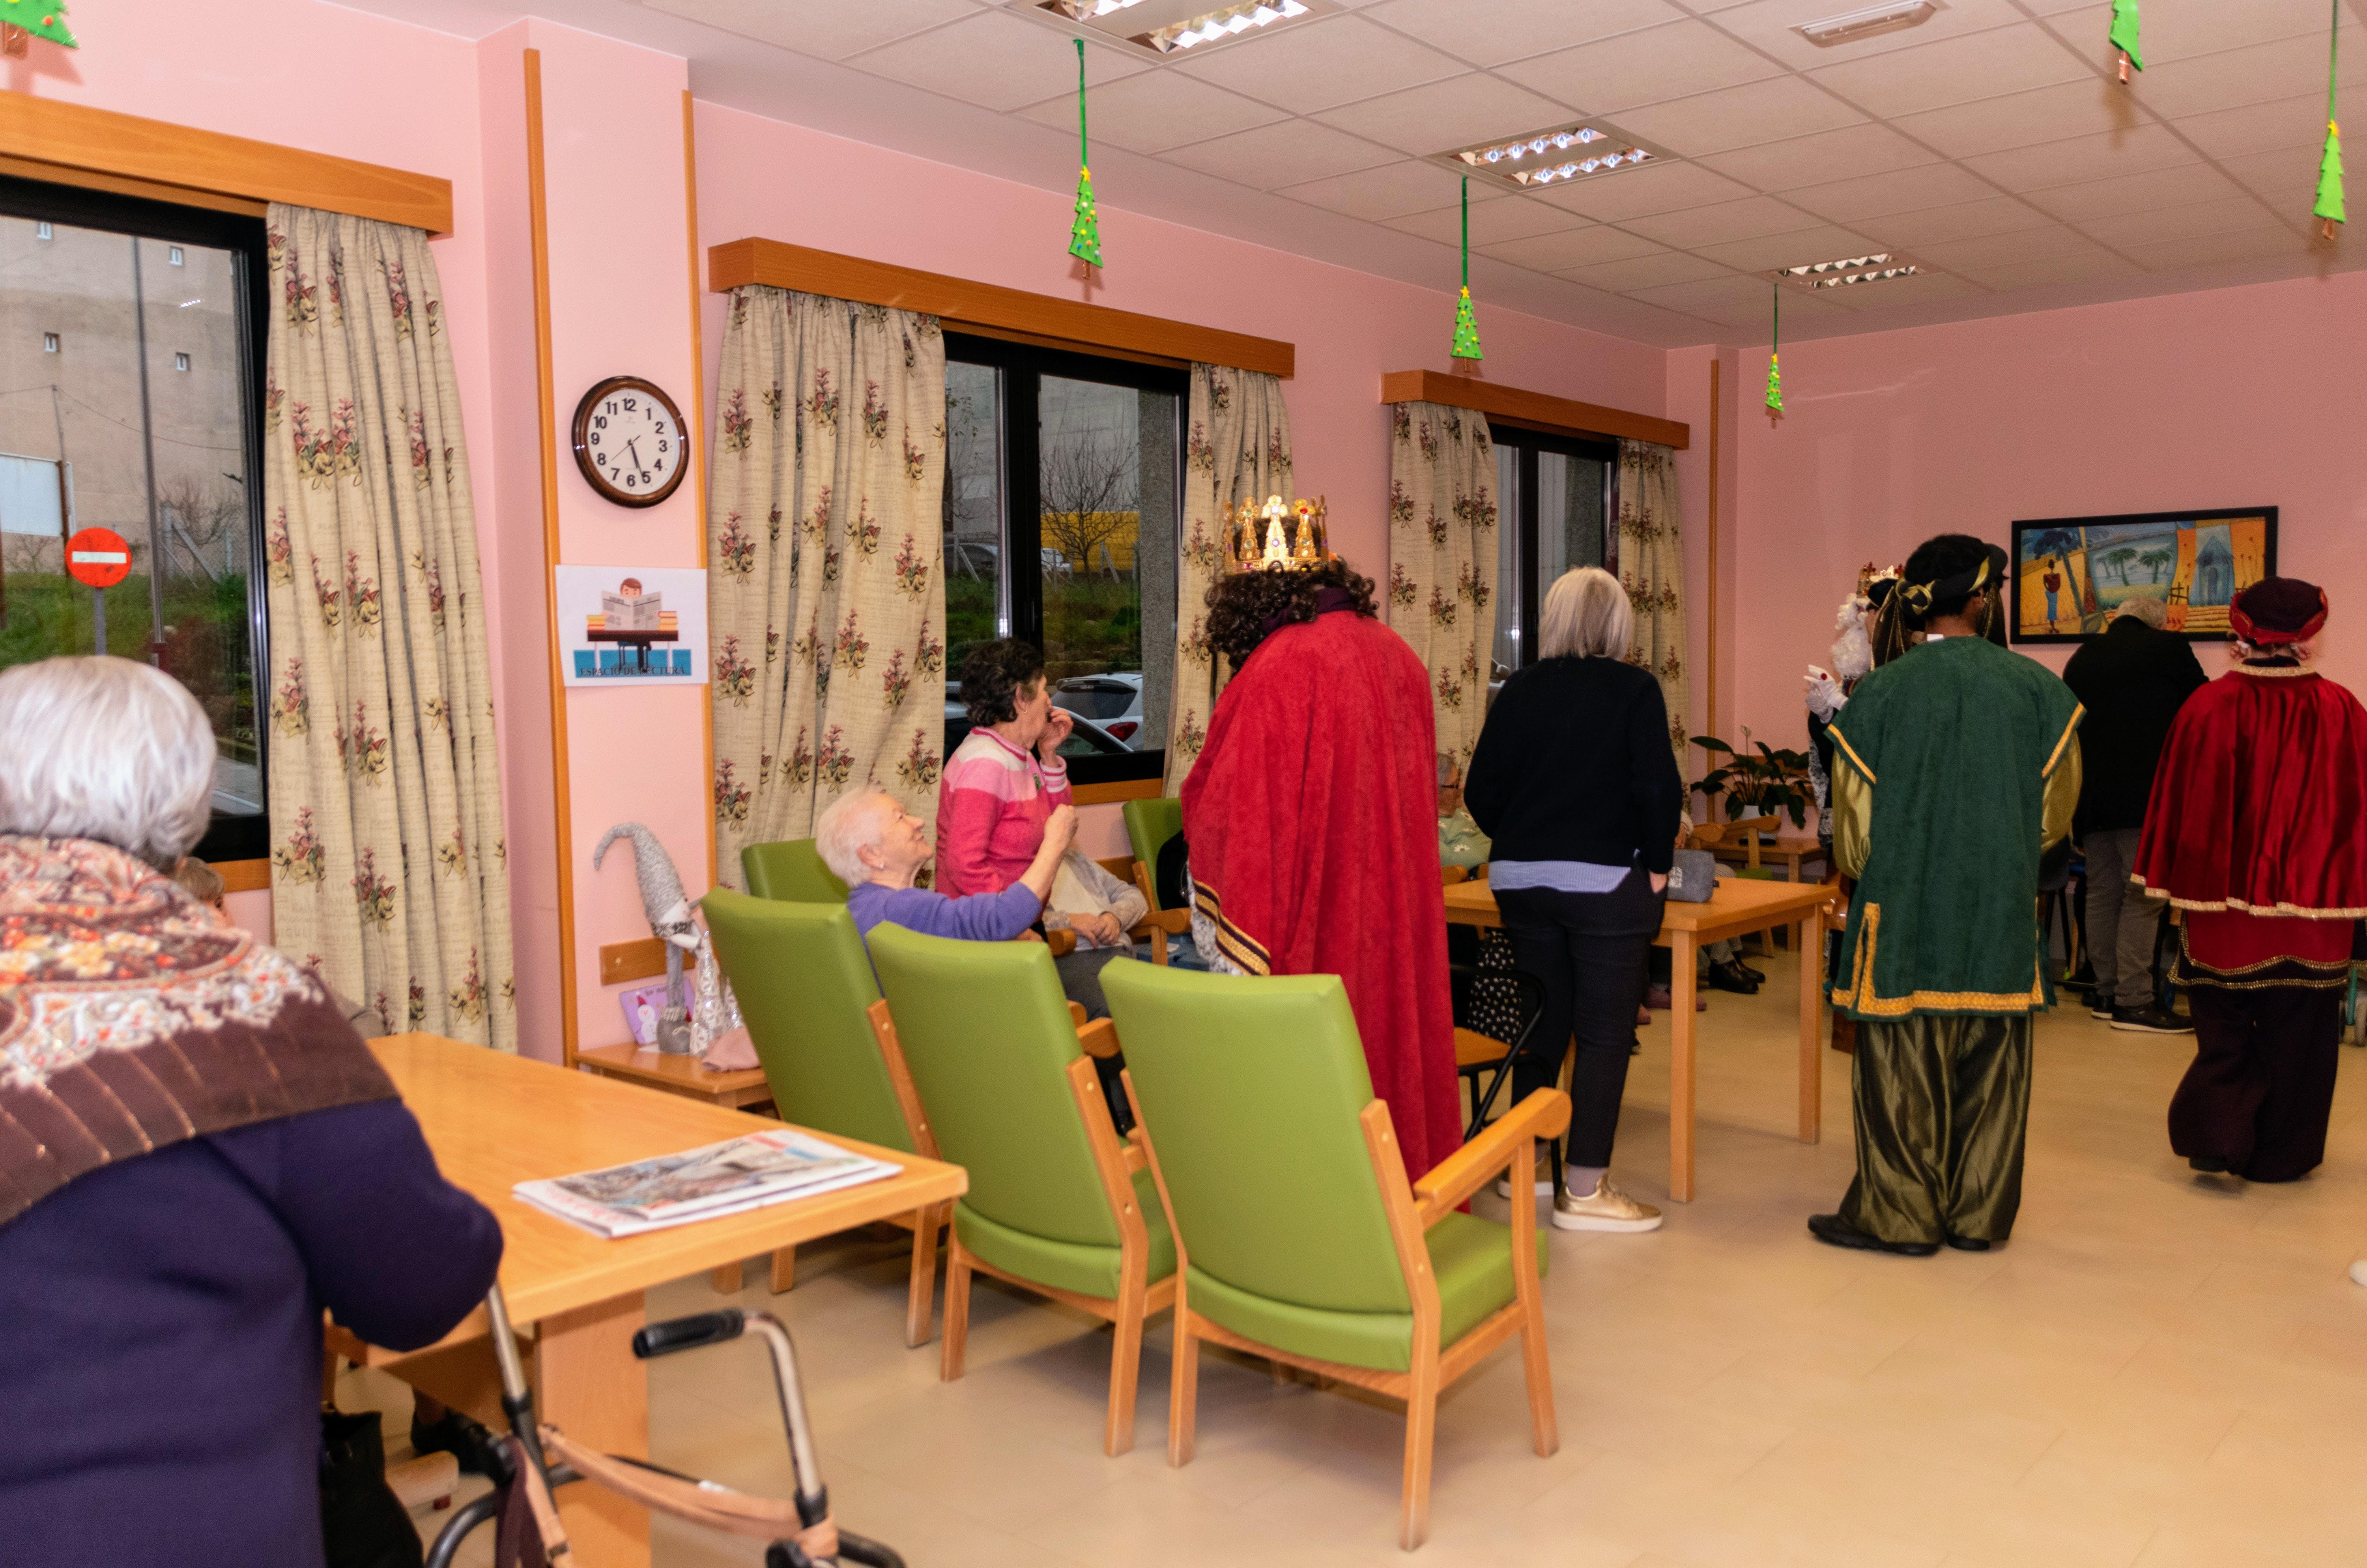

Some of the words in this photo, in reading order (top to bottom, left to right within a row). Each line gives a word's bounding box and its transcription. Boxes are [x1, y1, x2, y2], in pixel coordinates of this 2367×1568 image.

[605, 401, 618, 415] 11
[622, 398, 636, 411] 12
[645, 407, 651, 421] 1
[594, 415, 607, 429] 10
[655, 421, 664, 434] 2
[591, 432, 600, 445] 9
[659, 439, 667, 452] 3
[597, 452, 606, 465] 8
[654, 458, 663, 471] 4
[611, 467, 621, 480] 7
[642, 471, 651, 484] 5
[626, 474, 636, 487] 6
[581, 667, 621, 676] ESPACIO
